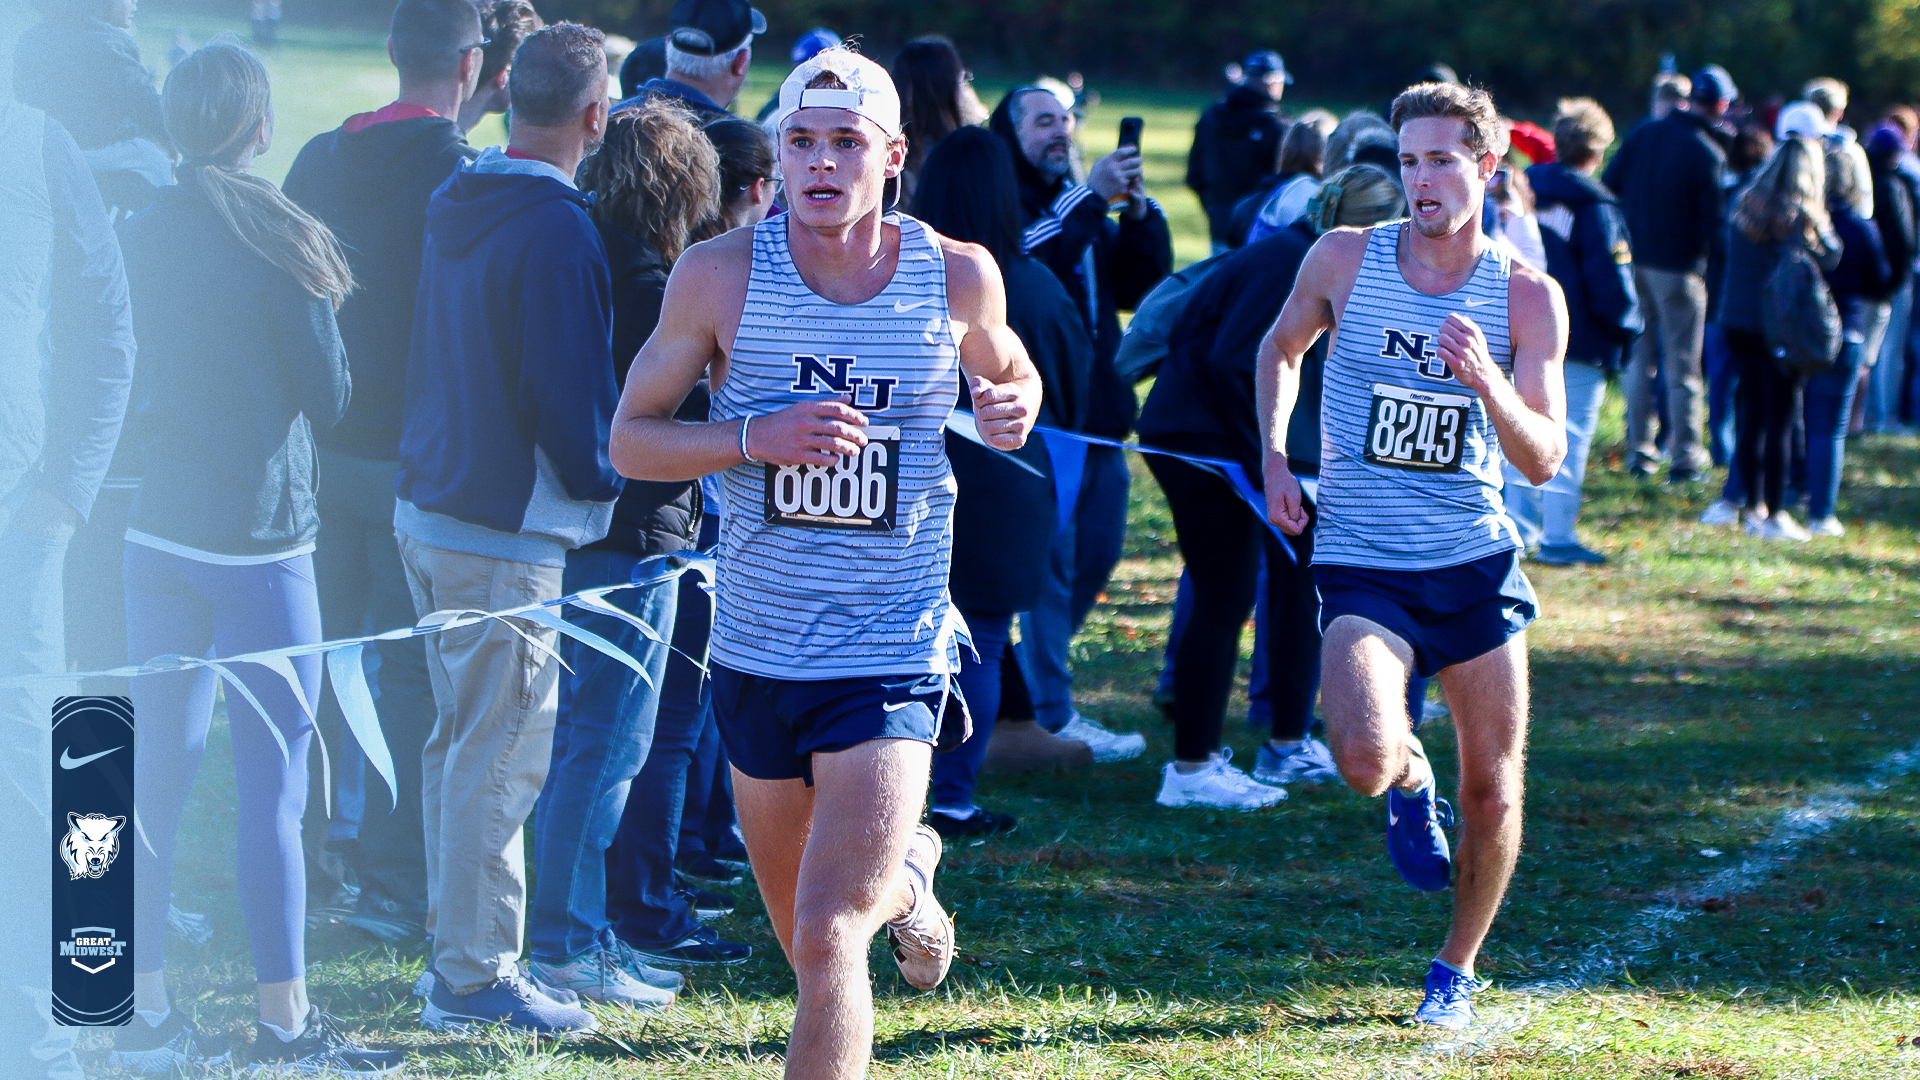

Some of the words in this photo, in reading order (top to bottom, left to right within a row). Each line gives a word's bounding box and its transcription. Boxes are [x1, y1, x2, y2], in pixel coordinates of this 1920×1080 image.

[790, 353, 900, 413] NU
[1380, 327, 1455, 382] NU
[1372, 399, 1460, 465] 8243
[774, 442, 889, 520] 8886
